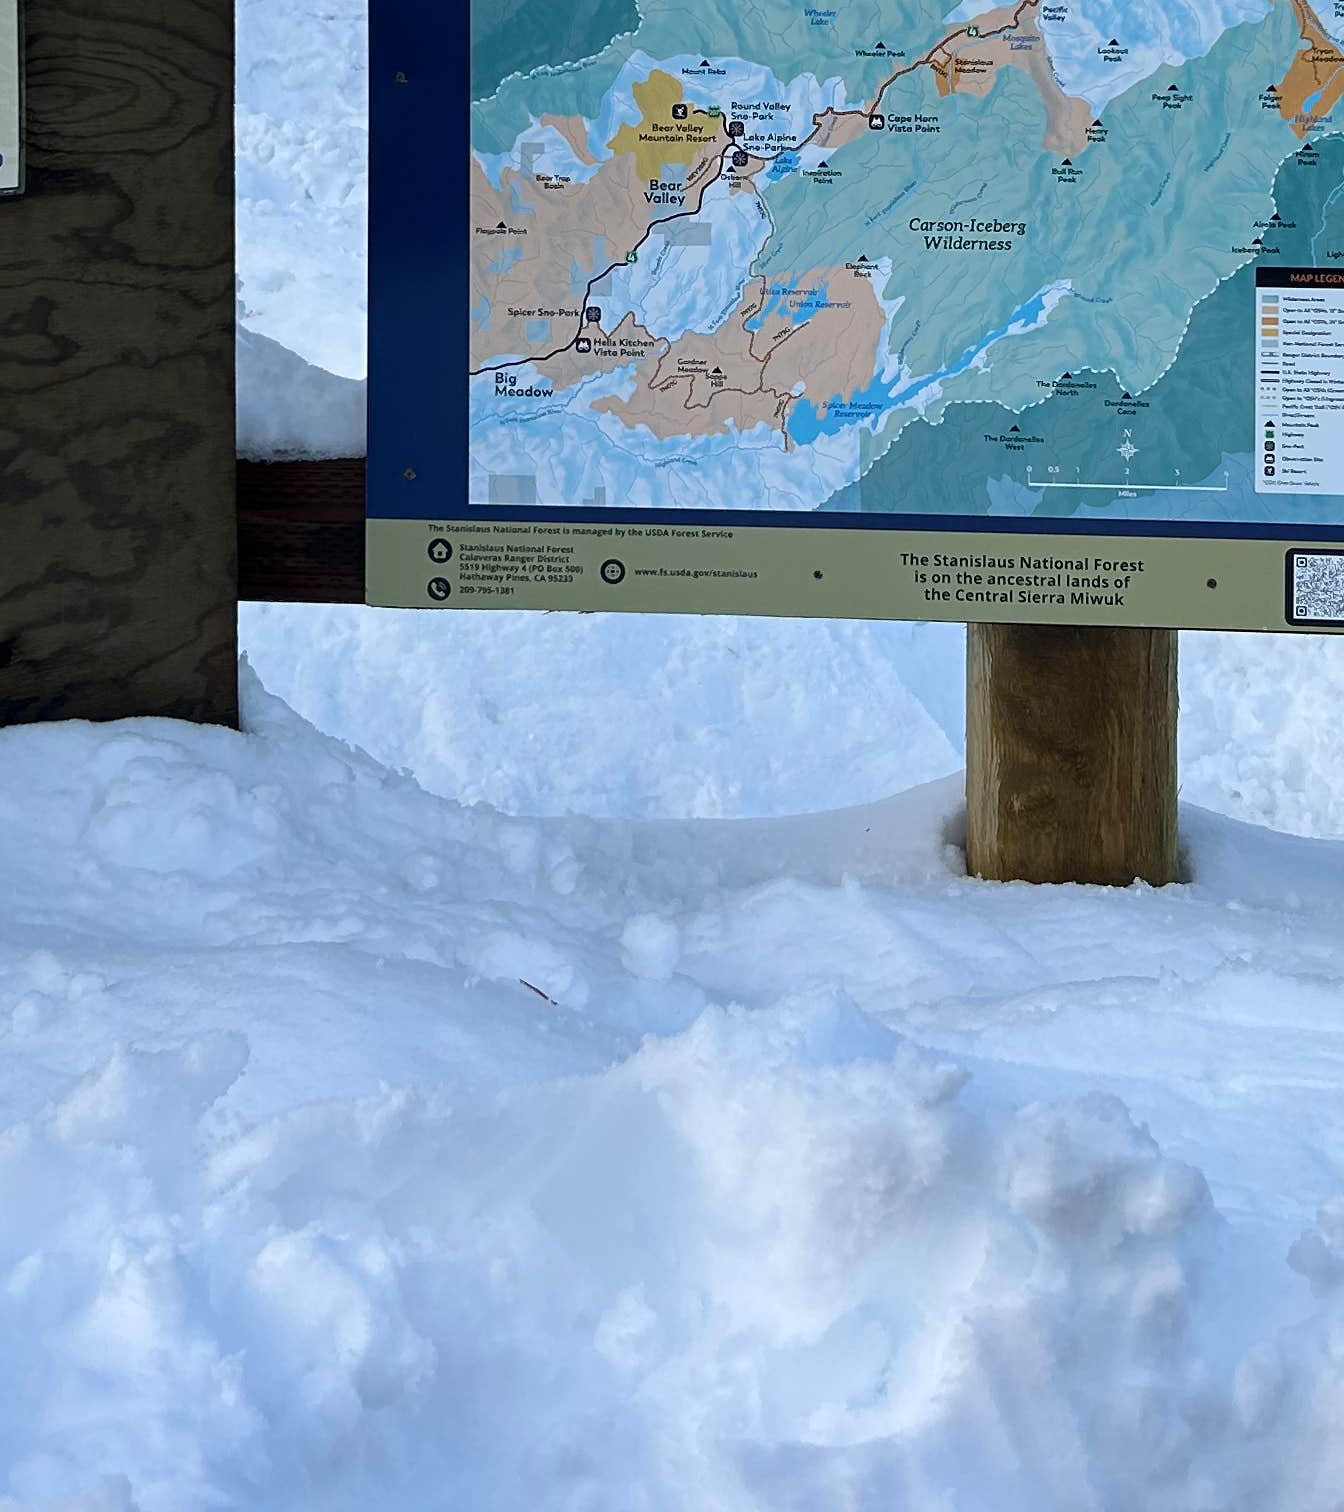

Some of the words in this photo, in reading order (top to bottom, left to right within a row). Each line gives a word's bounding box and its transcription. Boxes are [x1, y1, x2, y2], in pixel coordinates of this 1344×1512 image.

[888, 124, 913, 133] Vista
[915, 124, 940, 133] Point
[650, 180, 682, 191] Bear
[644, 192, 686, 207] Valley
[909, 218, 1027, 236] Carson-Iceberg
[924, 235, 1012, 251] Wilderness
[508, 308, 536, 319] Spicer
[538, 308, 580, 317] Sno-Park
[495, 373, 516, 386] Big
[495, 386, 553, 397] Meadow
[900, 553, 929, 566] The
[934, 554, 1015, 570] Stanislaus
[1020, 556, 1090, 571] National
[1094, 558, 1144, 572] Forest
[914, 570, 926, 584] is
[930, 573, 952, 584] on
[956, 571, 983, 585] the
[987, 572, 1061, 587] ancestral
[1066, 574, 1110, 588] lands
[1114, 575, 1131, 589] of
[924, 588, 951, 601] the
[955, 589, 1014, 604] Central
[1018, 590, 1066, 605] Sierra
[1070, 592, 1125, 607] Miwuk
